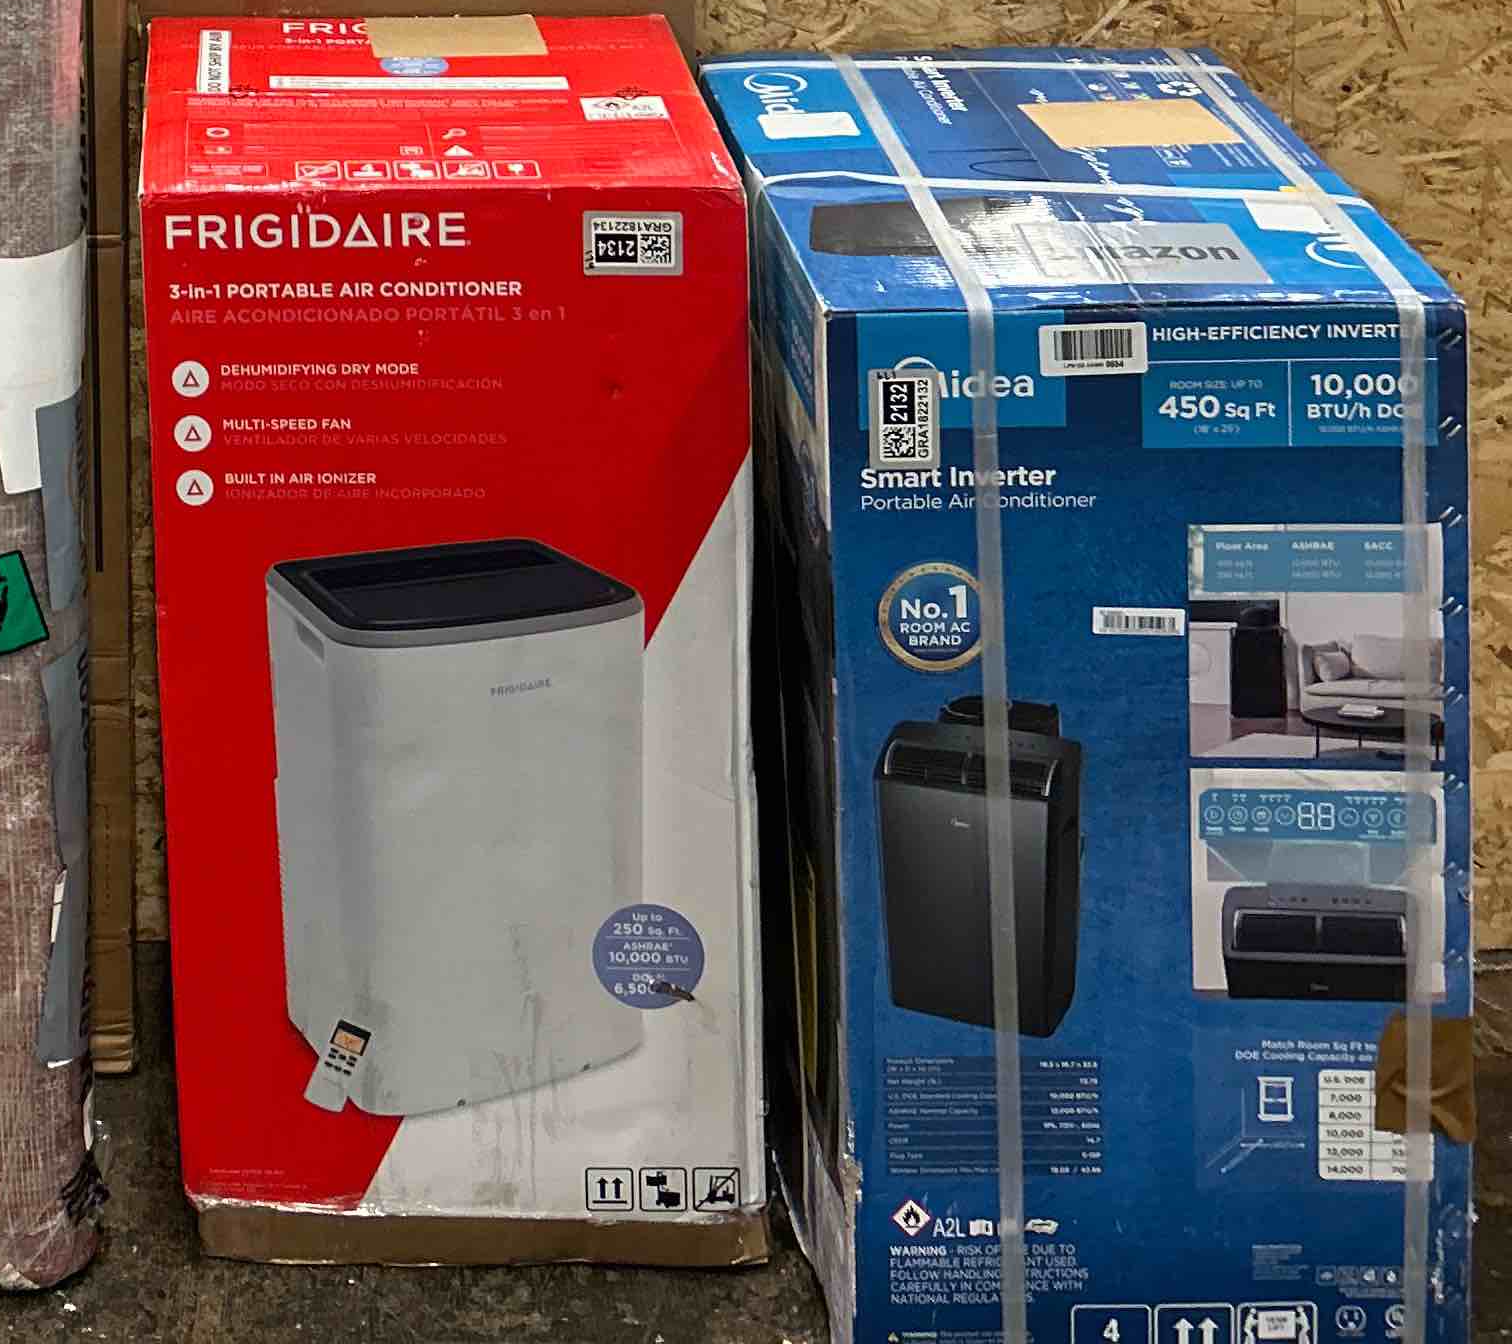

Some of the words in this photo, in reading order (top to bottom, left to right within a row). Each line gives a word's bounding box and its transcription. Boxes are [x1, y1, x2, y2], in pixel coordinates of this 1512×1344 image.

[208, 52, 222, 67] SHIP
[208, 67, 222, 82] NOT
[208, 82, 222, 93] DO
[164, 212, 467, 251] FRIGIDAIRE
[593, 221, 672, 233] GRA1822134
[597, 240, 636, 257] 2134
[169, 283, 221, 300] 3-in-1
[227, 282, 334, 300] PORTABLE
[339, 281, 374, 299] AIR
[380, 280, 523, 299] CONDITIONER
[170, 309, 217, 325] AIRE
[223, 307, 400, 324] ACONDICIONADO
[406, 303, 505, 323] PORTÁTIL
[512, 306, 522, 321] 3
[529, 309, 552, 321] en
[1153, 324, 1320, 342] HIGH-EFFICIENCY
[221, 363, 337, 378] DEHUMIDIFYING
[341, 363, 371, 376] DRY
[375, 363, 420, 376] MODE
[1310, 373, 1418, 398] 10,000
[890, 382, 908, 423] 2132
[1158, 394, 1220, 420] 450
[1224, 404, 1251, 421] Sq
[1255, 402, 1276, 418] Ft
[916, 378, 929, 459] GRA1822132
[1307, 403, 1371, 421] BTU/h
[223, 418, 317, 431] MULTI-SPEED
[322, 418, 352, 430] FAN
[224, 472, 266, 485] BUILT
[270, 472, 285, 485] IN
[288, 472, 313, 485] AIR
[317, 472, 377, 484] IONIZER
[861, 468, 942, 489] Smart
[861, 494, 943, 511] Portable
[948, 493, 976, 509] Air
[992, 493, 1097, 509] onditioner
[900, 622, 945, 634] ROOM
[950, 622, 971, 633] AC
[908, 634, 962, 647] BRAND
[613, 923, 643, 936] 250
[609, 952, 662, 965] 10,000
[665, 954, 689, 965] BTU
[933, 1217, 966, 1238] A2L
[889, 1246, 947, 1257] WARNING
[957, 1245, 982, 1256] RISK
[1032, 1244, 1056, 1255] DUE
[1059, 1244, 1075, 1255] TO
[889, 1257, 960, 1269] FLAMMABLE
[889, 1269, 938, 1280] FOLLOW
[890, 1281, 957, 1292] CAREFULLY
[960, 1281, 972, 1291] IN
[1052, 1280, 1083, 1291] WITH
[891, 1293, 949, 1305] NATIONAL
[1102, 1317, 1120, 1343] 4
